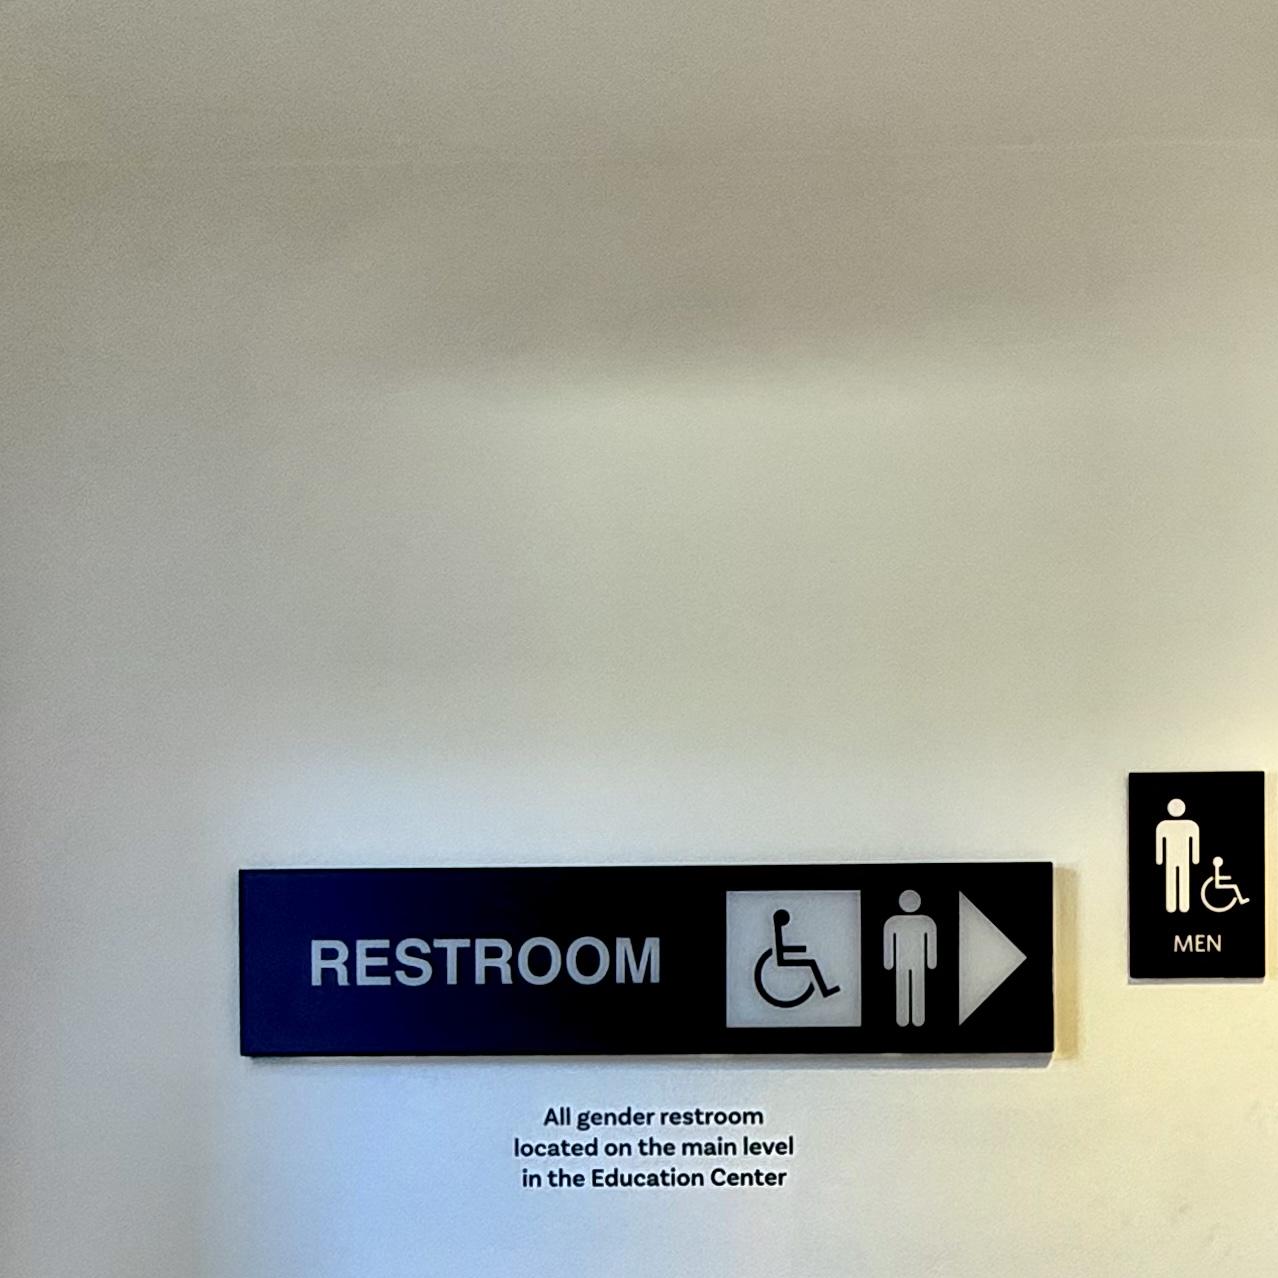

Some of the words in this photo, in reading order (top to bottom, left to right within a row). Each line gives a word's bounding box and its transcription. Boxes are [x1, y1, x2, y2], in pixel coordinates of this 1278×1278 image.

[1173, 934, 1222, 953] MEN
[310, 936, 661, 988] RESTROOM
[543, 1106, 571, 1127] All
[576, 1106, 656, 1132] gender
[660, 1108, 764, 1126] restroom
[514, 1136, 599, 1157] located
[604, 1142, 632, 1157] on
[637, 1136, 676, 1157] the
[681, 1135, 737, 1157] main
[743, 1135, 794, 1156] level
[522, 1167, 542, 1188] in
[546, 1167, 586, 1188] the
[591, 1166, 705, 1188] Education
[710, 1167, 788, 1187] Center
